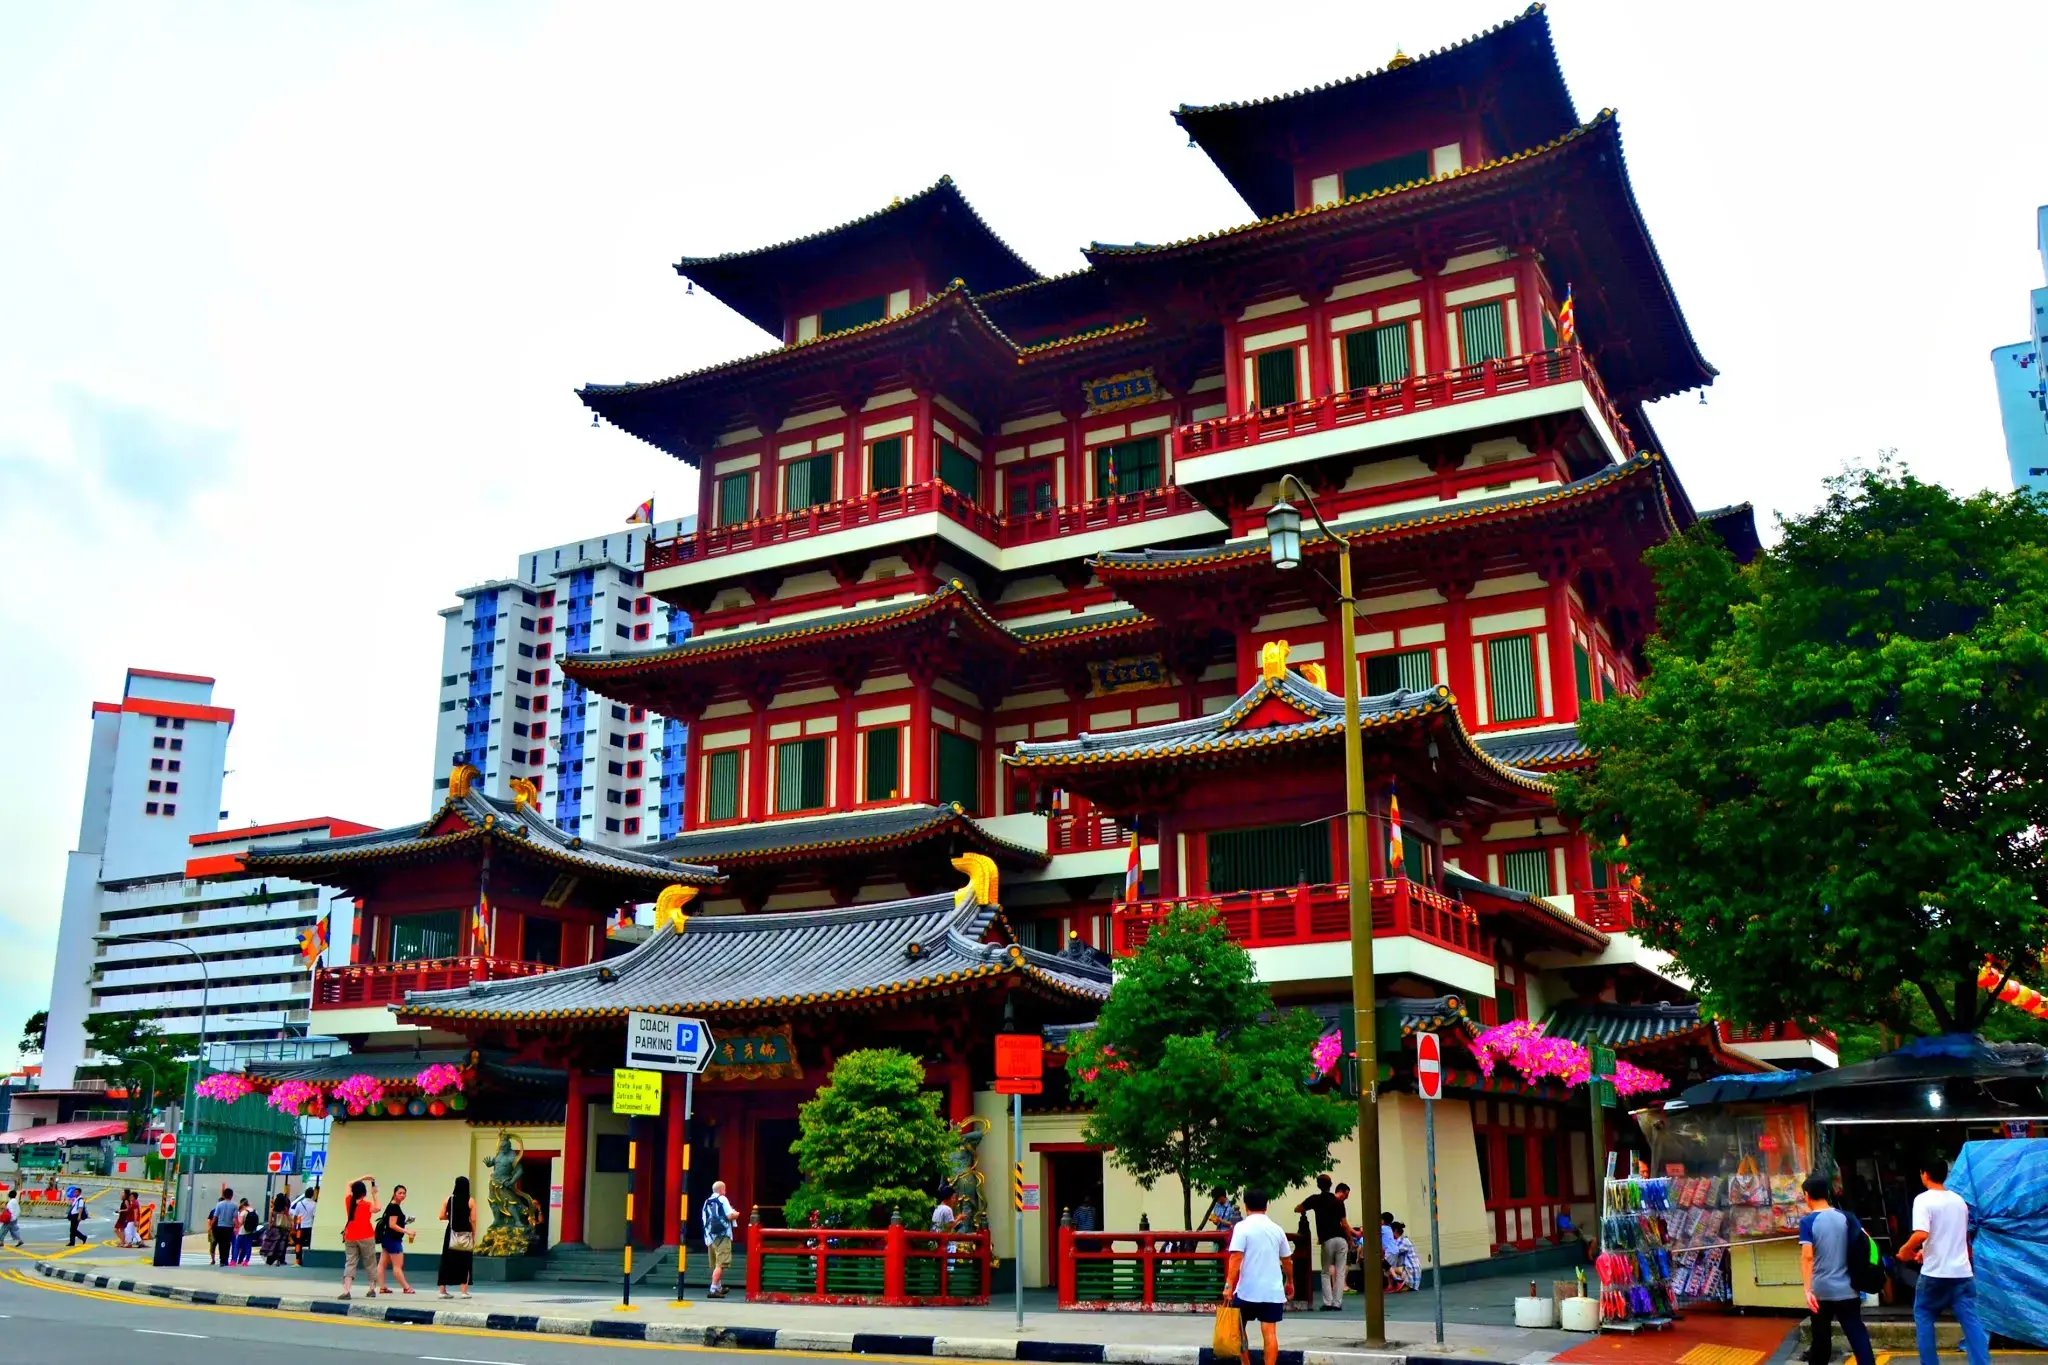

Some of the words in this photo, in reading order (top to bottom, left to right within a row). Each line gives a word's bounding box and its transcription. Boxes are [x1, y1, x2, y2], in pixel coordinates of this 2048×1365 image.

[640, 1018, 669, 1033] COACH
[635, 1035, 672, 1051] PARKING
[682, 1029, 694, 1047] P
[645, 1083, 652, 1091] Rd
[645, 1103, 652, 1111] Rd
